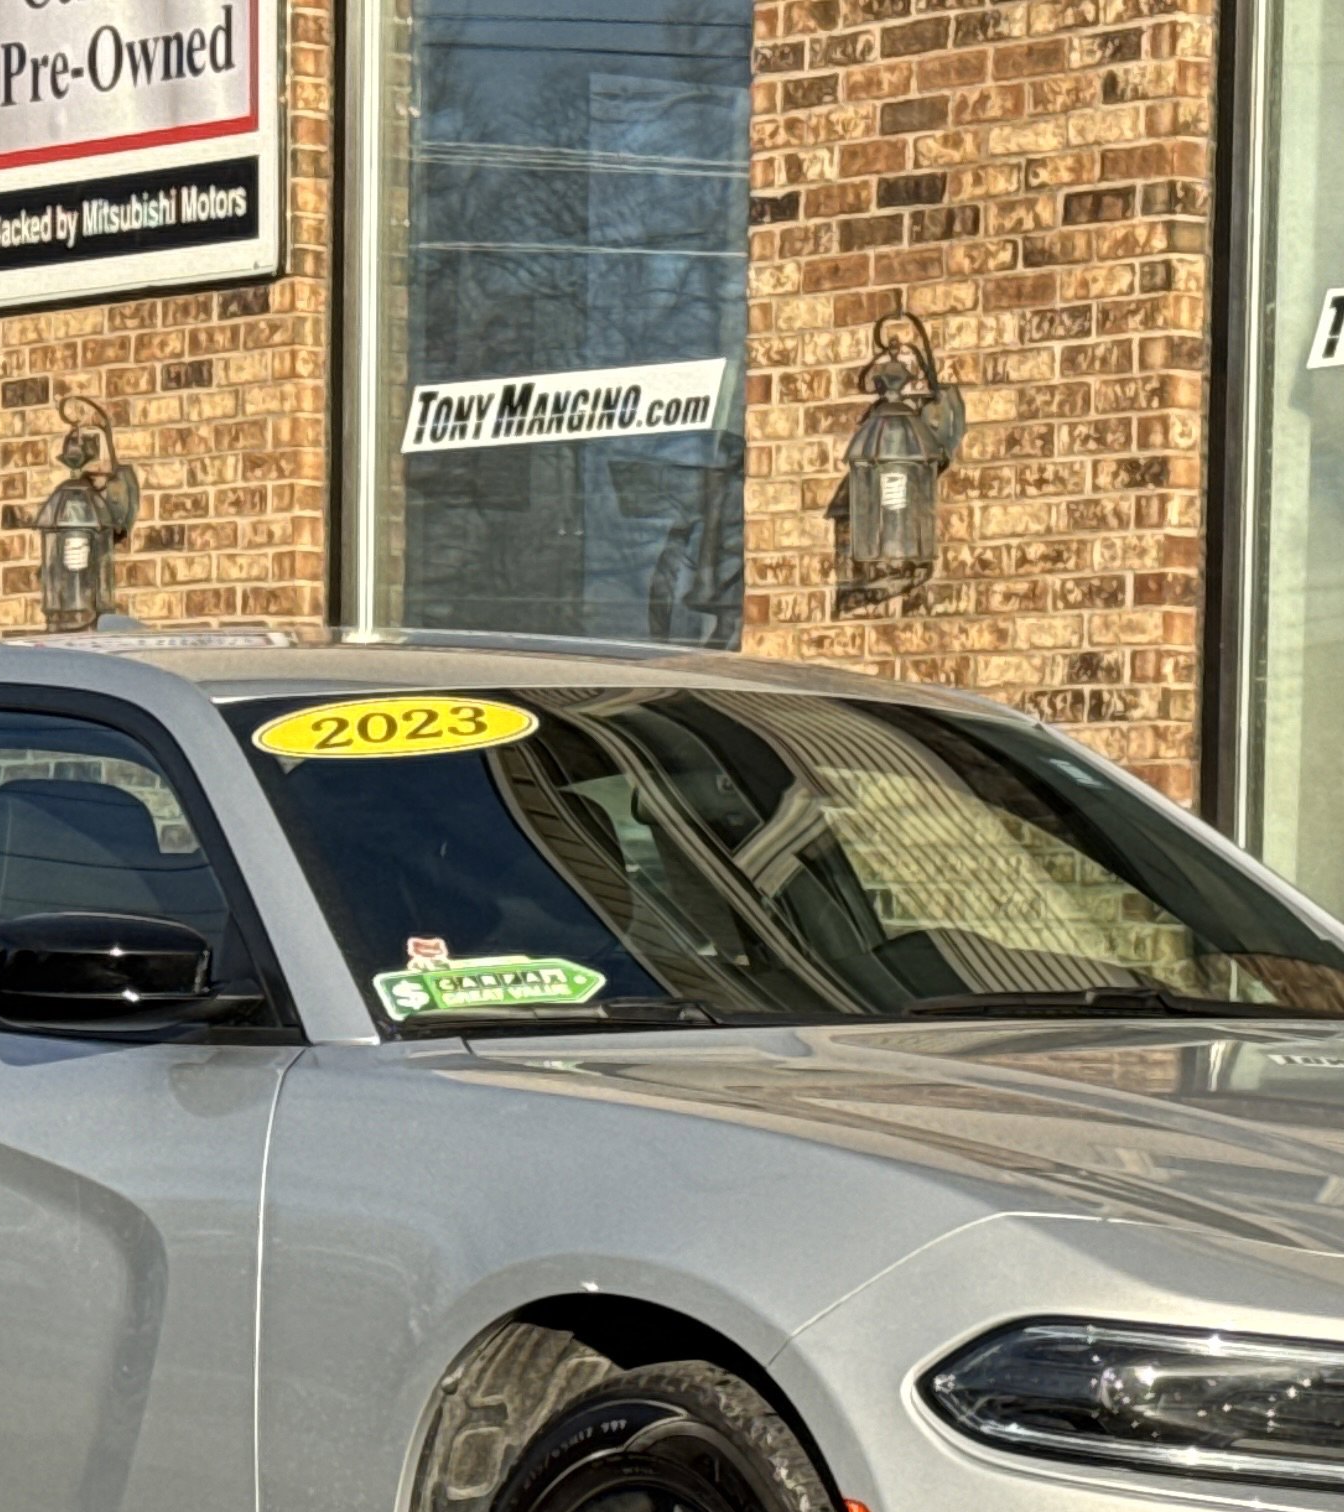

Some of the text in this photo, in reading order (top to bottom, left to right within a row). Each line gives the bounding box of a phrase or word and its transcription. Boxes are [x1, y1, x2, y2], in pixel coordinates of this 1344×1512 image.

[0, 4, 236, 107] Pre-Owned
[55, 204, 79, 249] by
[82, 186, 177, 237] Mitsubishi
[180, 184, 248, 224] Motors
[311, 705, 489, 751] 2023
